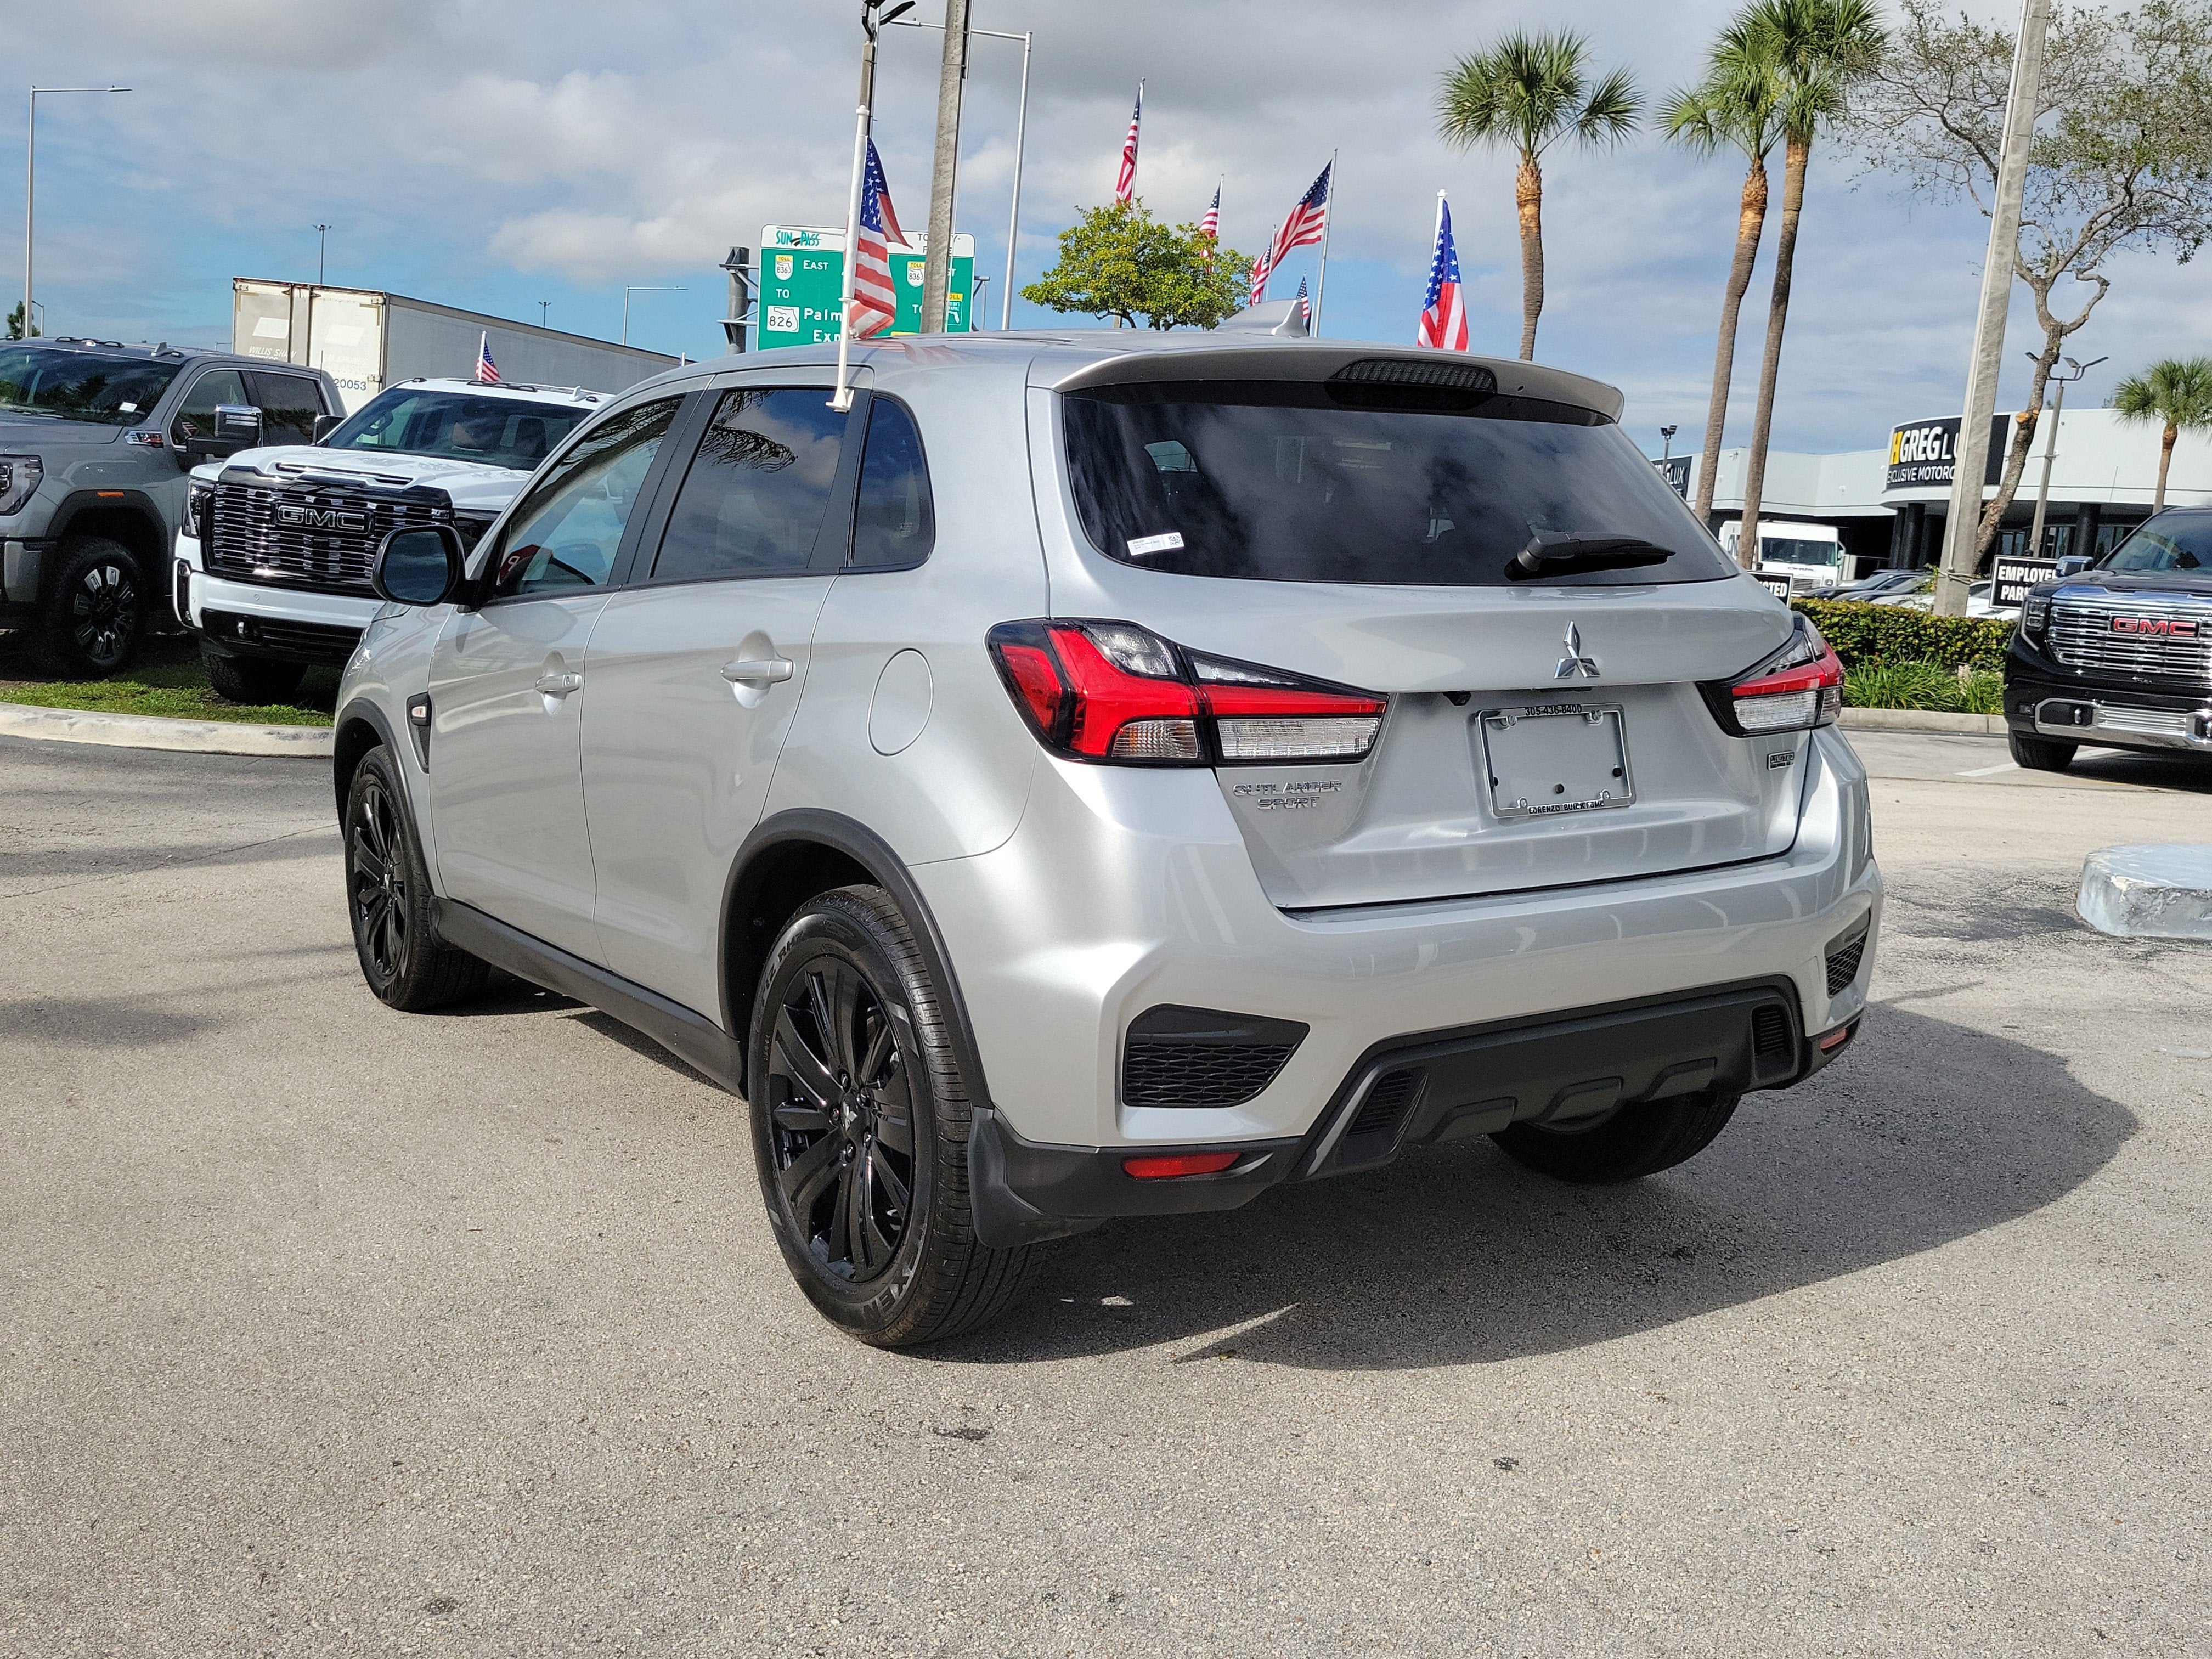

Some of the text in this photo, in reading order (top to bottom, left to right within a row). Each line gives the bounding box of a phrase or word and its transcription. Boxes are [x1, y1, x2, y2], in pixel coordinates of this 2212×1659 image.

[803, 259, 829, 270] EAST
[776, 288, 790, 298] TO
[769, 315, 793, 328] 826
[249, 346, 273, 356] WILLIS
[334, 378, 366, 391] 20053
[278, 505, 365, 531] GMC
[2114, 617, 2196, 636] GMC
[1525, 704, 1582, 716] 305-436-8400
[1233, 780, 1342, 796] OUTLANDER
[1257, 797, 1320, 810] SPORT
[1528, 805, 1560, 814] LORENZO
